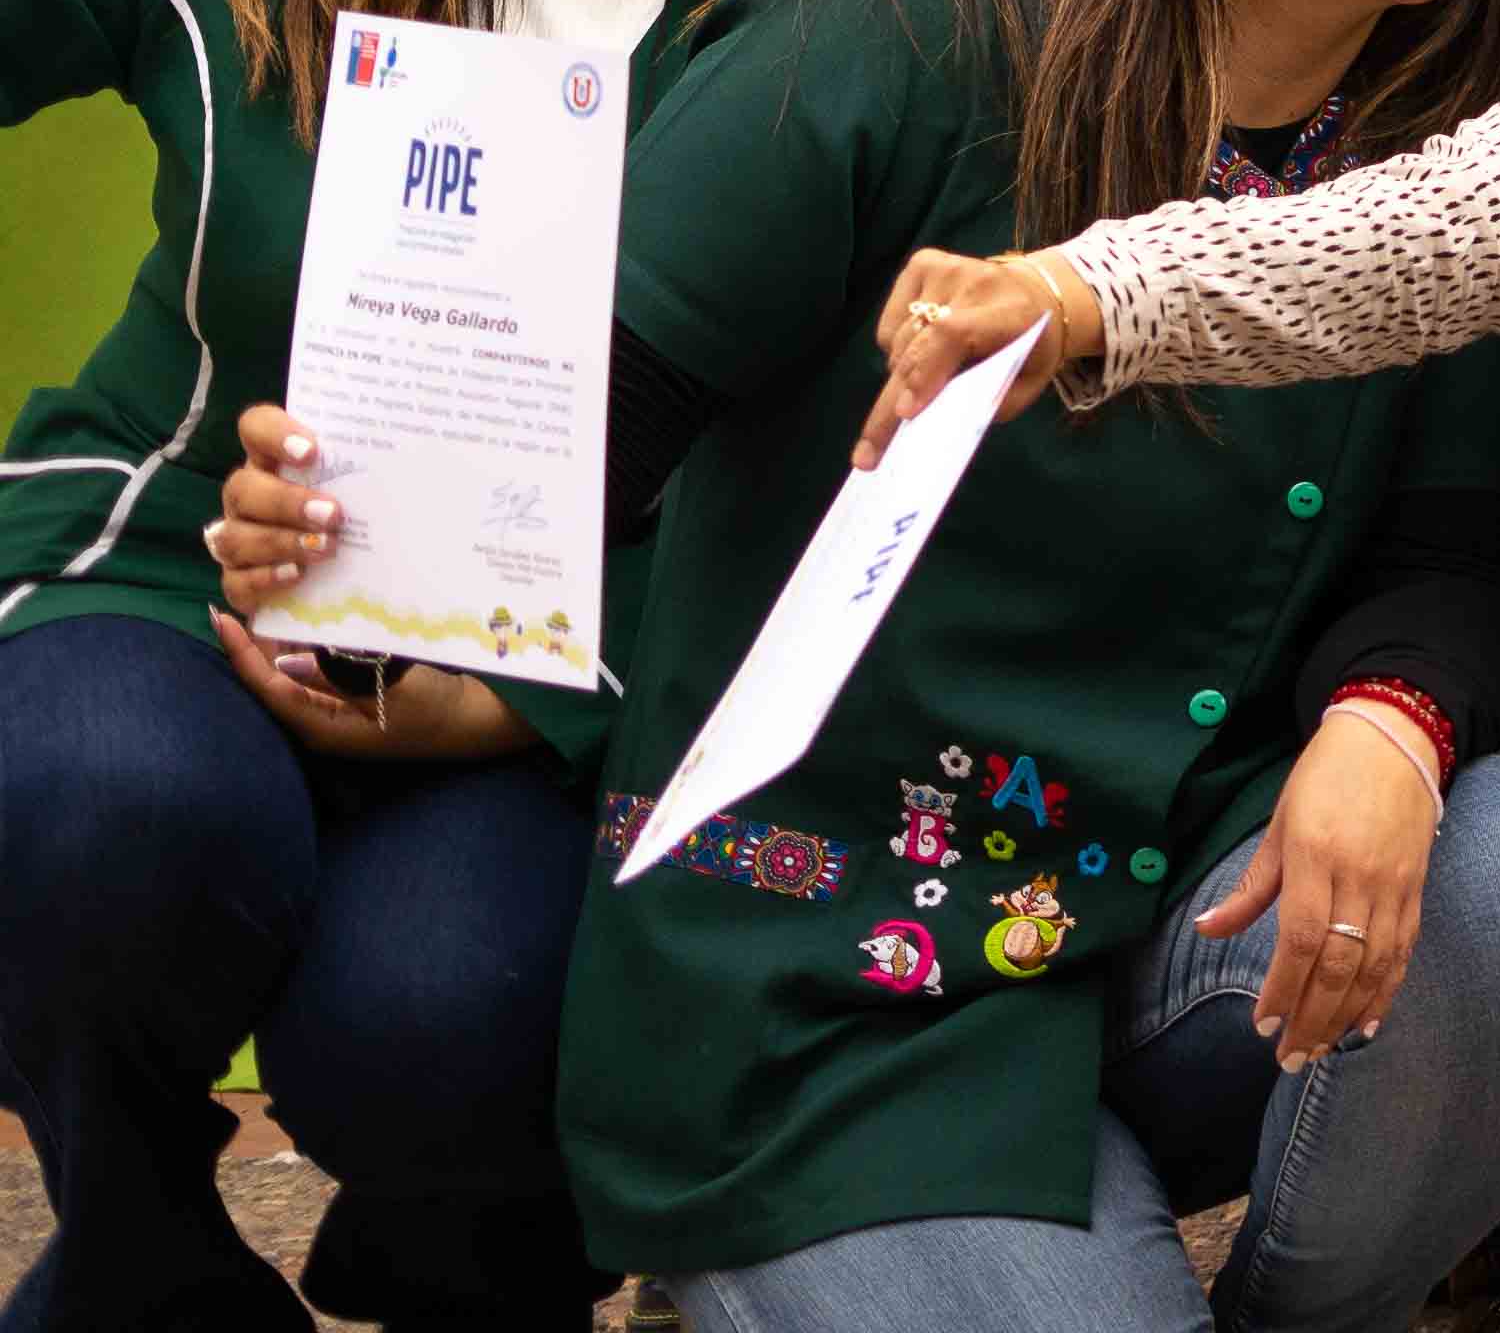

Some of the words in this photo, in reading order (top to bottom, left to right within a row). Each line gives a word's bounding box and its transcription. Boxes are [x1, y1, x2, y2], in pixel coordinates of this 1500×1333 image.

[403, 138, 483, 216] PIPE
[347, 292, 395, 317] Mireya
[400, 301, 441, 325] Vega
[445, 308, 518, 334] Gallardo
[992, 755, 1048, 828] A
